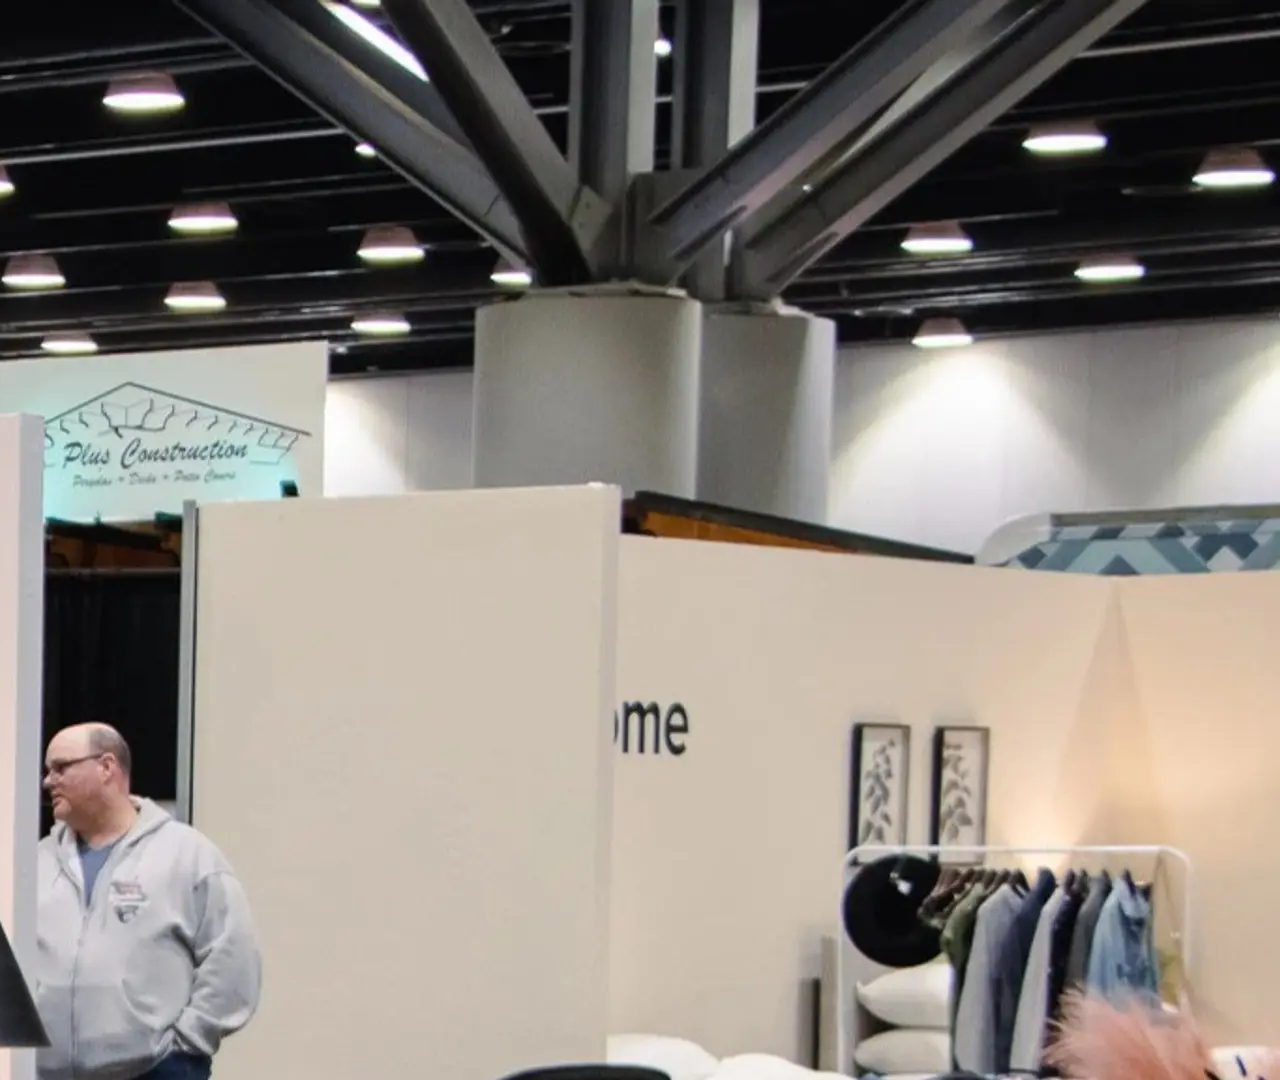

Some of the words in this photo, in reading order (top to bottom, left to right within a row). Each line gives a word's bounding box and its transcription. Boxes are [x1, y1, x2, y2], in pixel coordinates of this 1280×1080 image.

[62, 441, 110, 469] Plus
[120, 438, 248, 469] Construction
[614, 700, 689, 756] me
